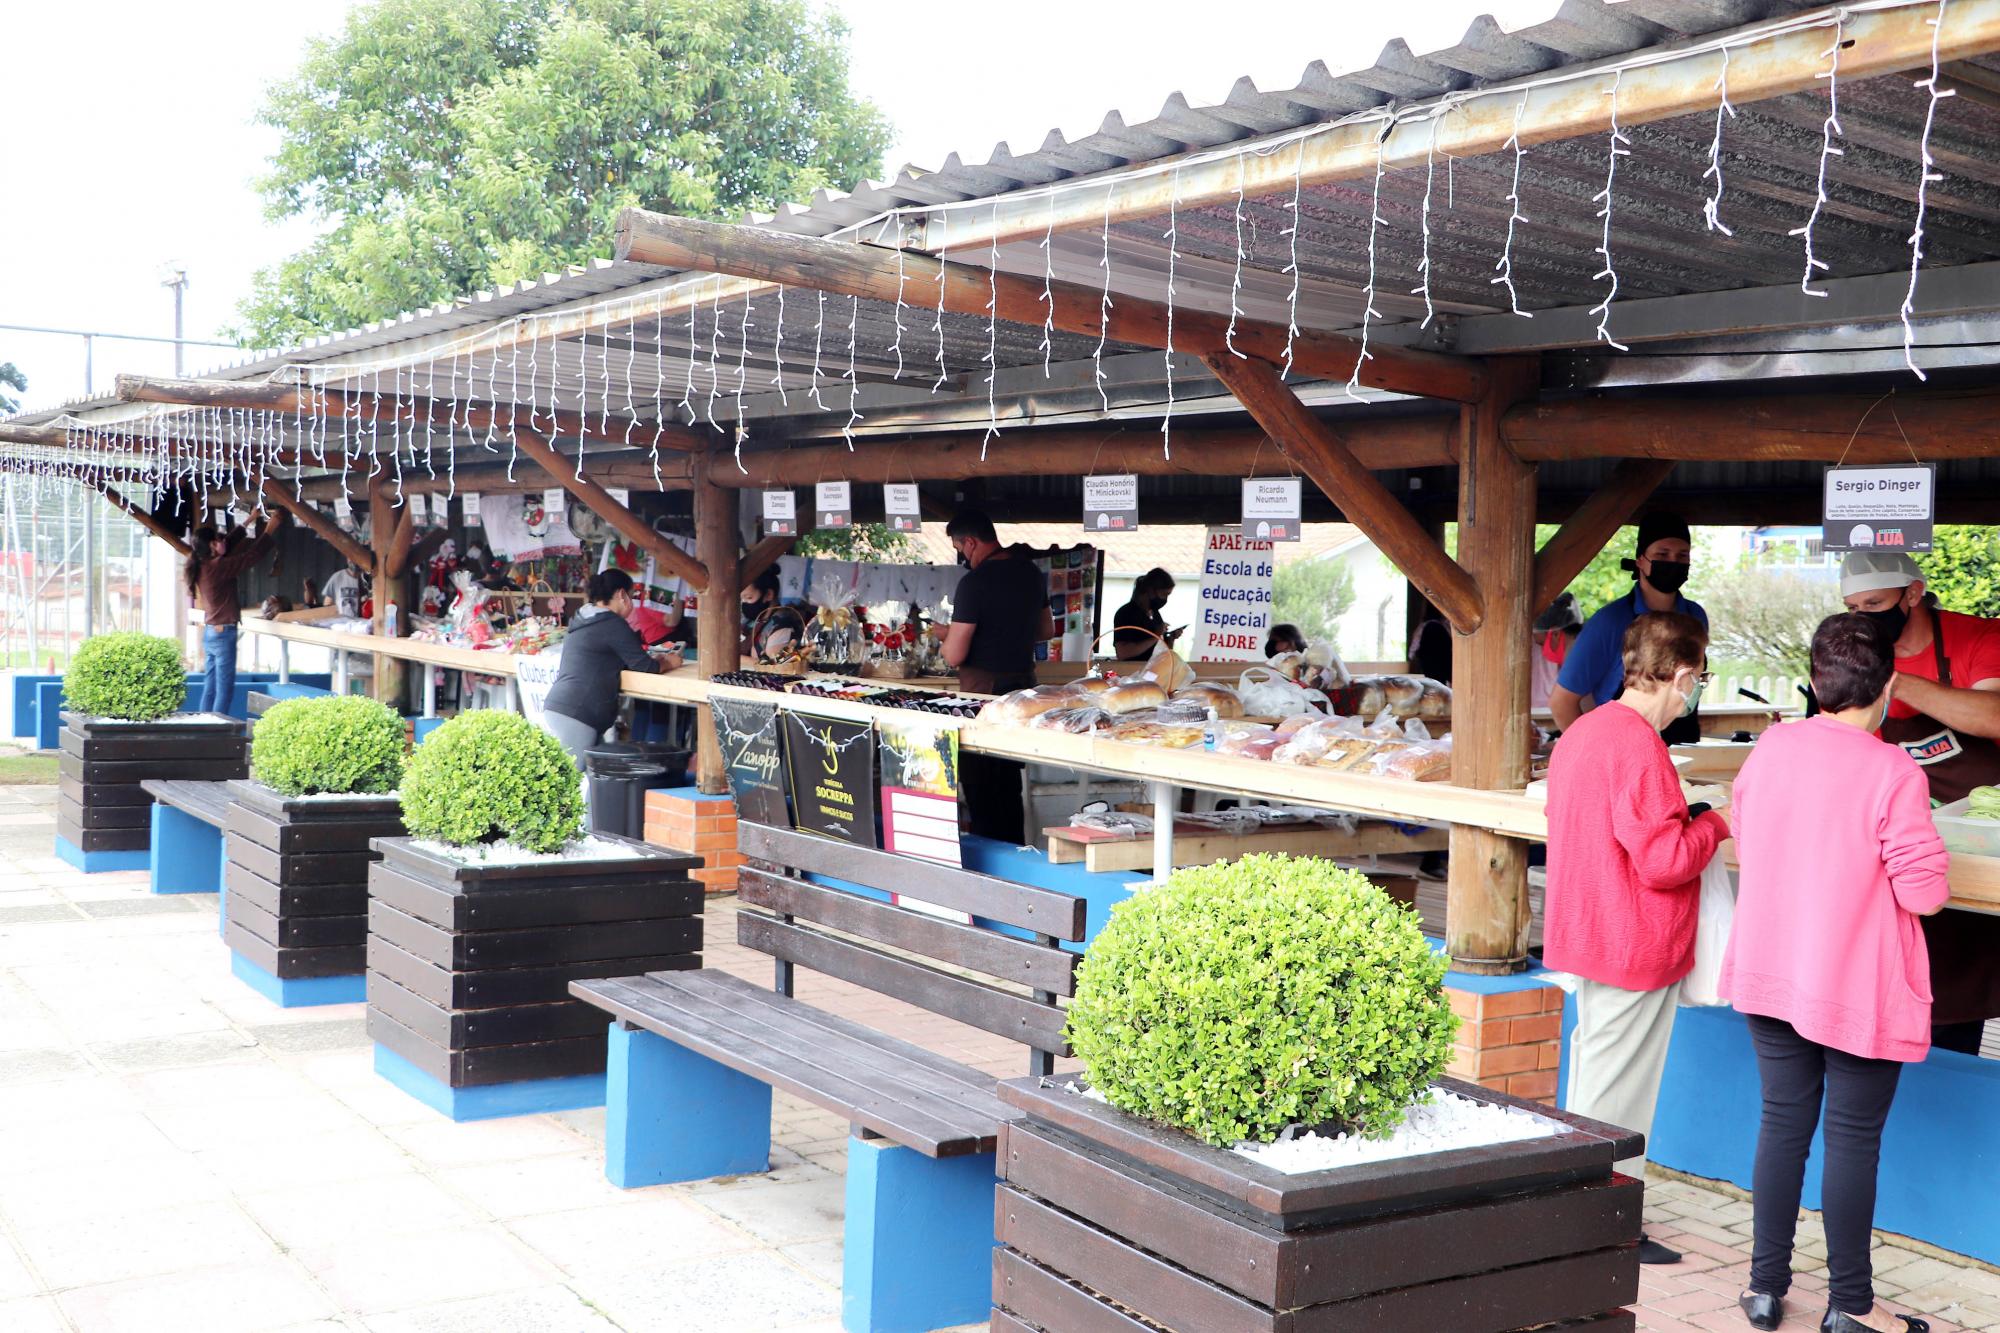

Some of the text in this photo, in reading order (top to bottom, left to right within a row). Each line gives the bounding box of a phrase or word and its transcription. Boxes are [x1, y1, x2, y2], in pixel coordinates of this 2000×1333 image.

[1086, 480, 1108, 488] Claudia
[1258, 485, 1285, 494] Ricardo
[1835, 479, 1921, 493] Sergio Dinger
[1255, 495, 1288, 504] Neumann
[1209, 534, 1242, 550] APAE
[1876, 532, 1905, 546] LUA
[1205, 559, 1273, 577] Escola de
[1202, 585, 1272, 605] educação
[1204, 608, 1267, 628] Especial
[1208, 633, 1257, 650] PADRE
[518, 661, 549, 685] Clube
[1921, 740, 1952, 758] LUA
[815, 785, 854, 805] SOCREPPA
